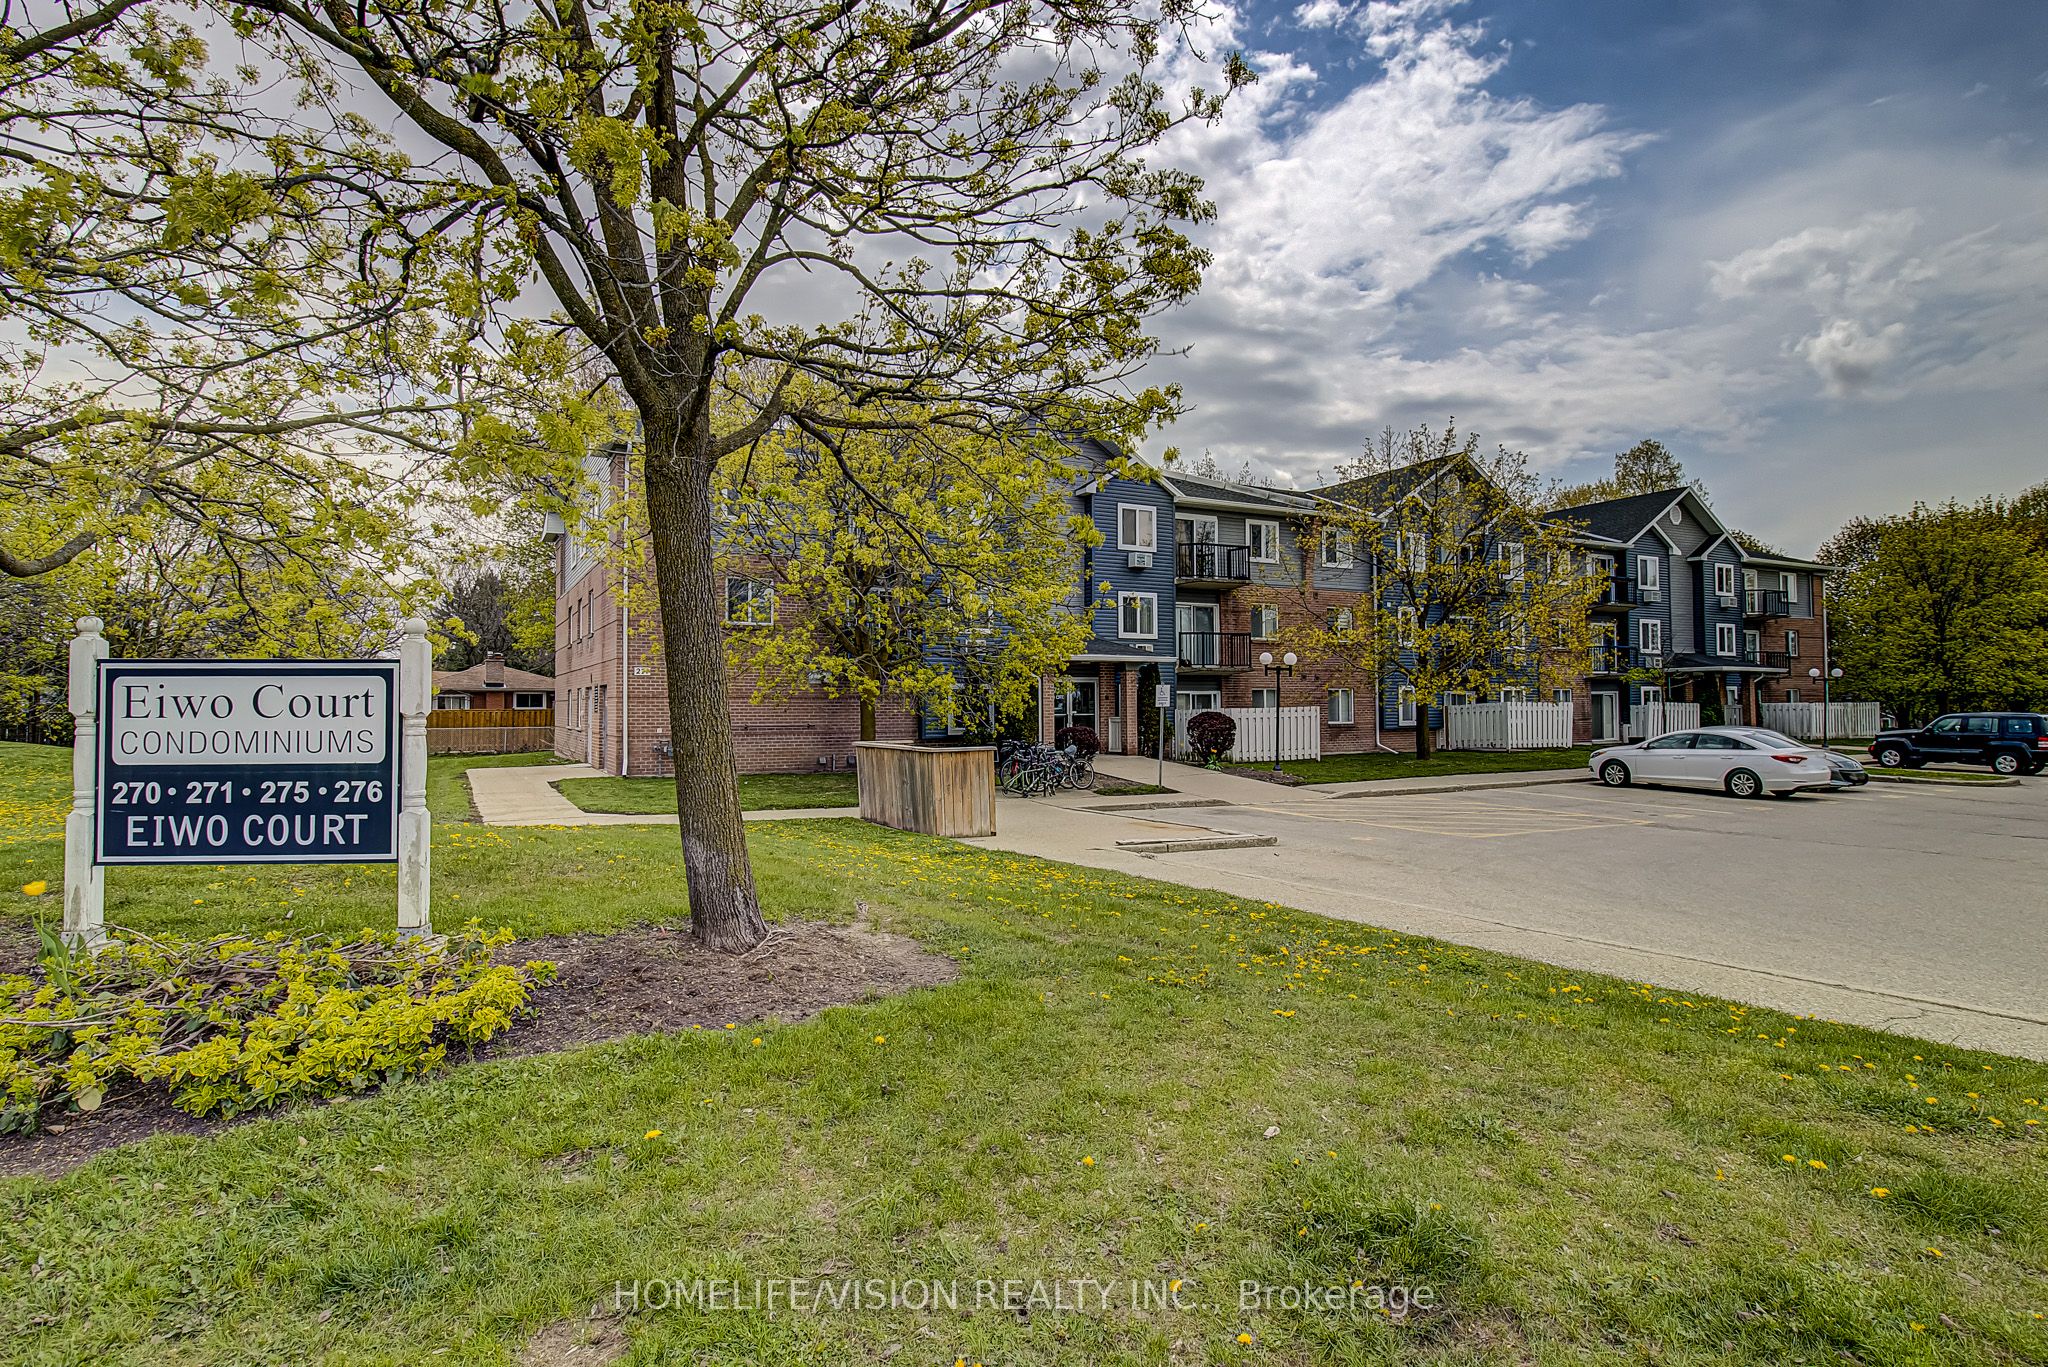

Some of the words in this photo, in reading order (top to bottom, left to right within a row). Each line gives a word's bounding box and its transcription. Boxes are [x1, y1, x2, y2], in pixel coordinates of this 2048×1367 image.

[121, 684, 234, 719] Eiwo
[252, 684, 375, 719] Court
[120, 729, 374, 755] CONDOMINIUMS
[111, 781, 161, 804] 270
[185, 781, 233, 804] 271
[260, 781, 309, 803] 275
[333, 780, 383, 803] 276
[127, 814, 229, 847] EIWO
[243, 814, 368, 846] COURT
